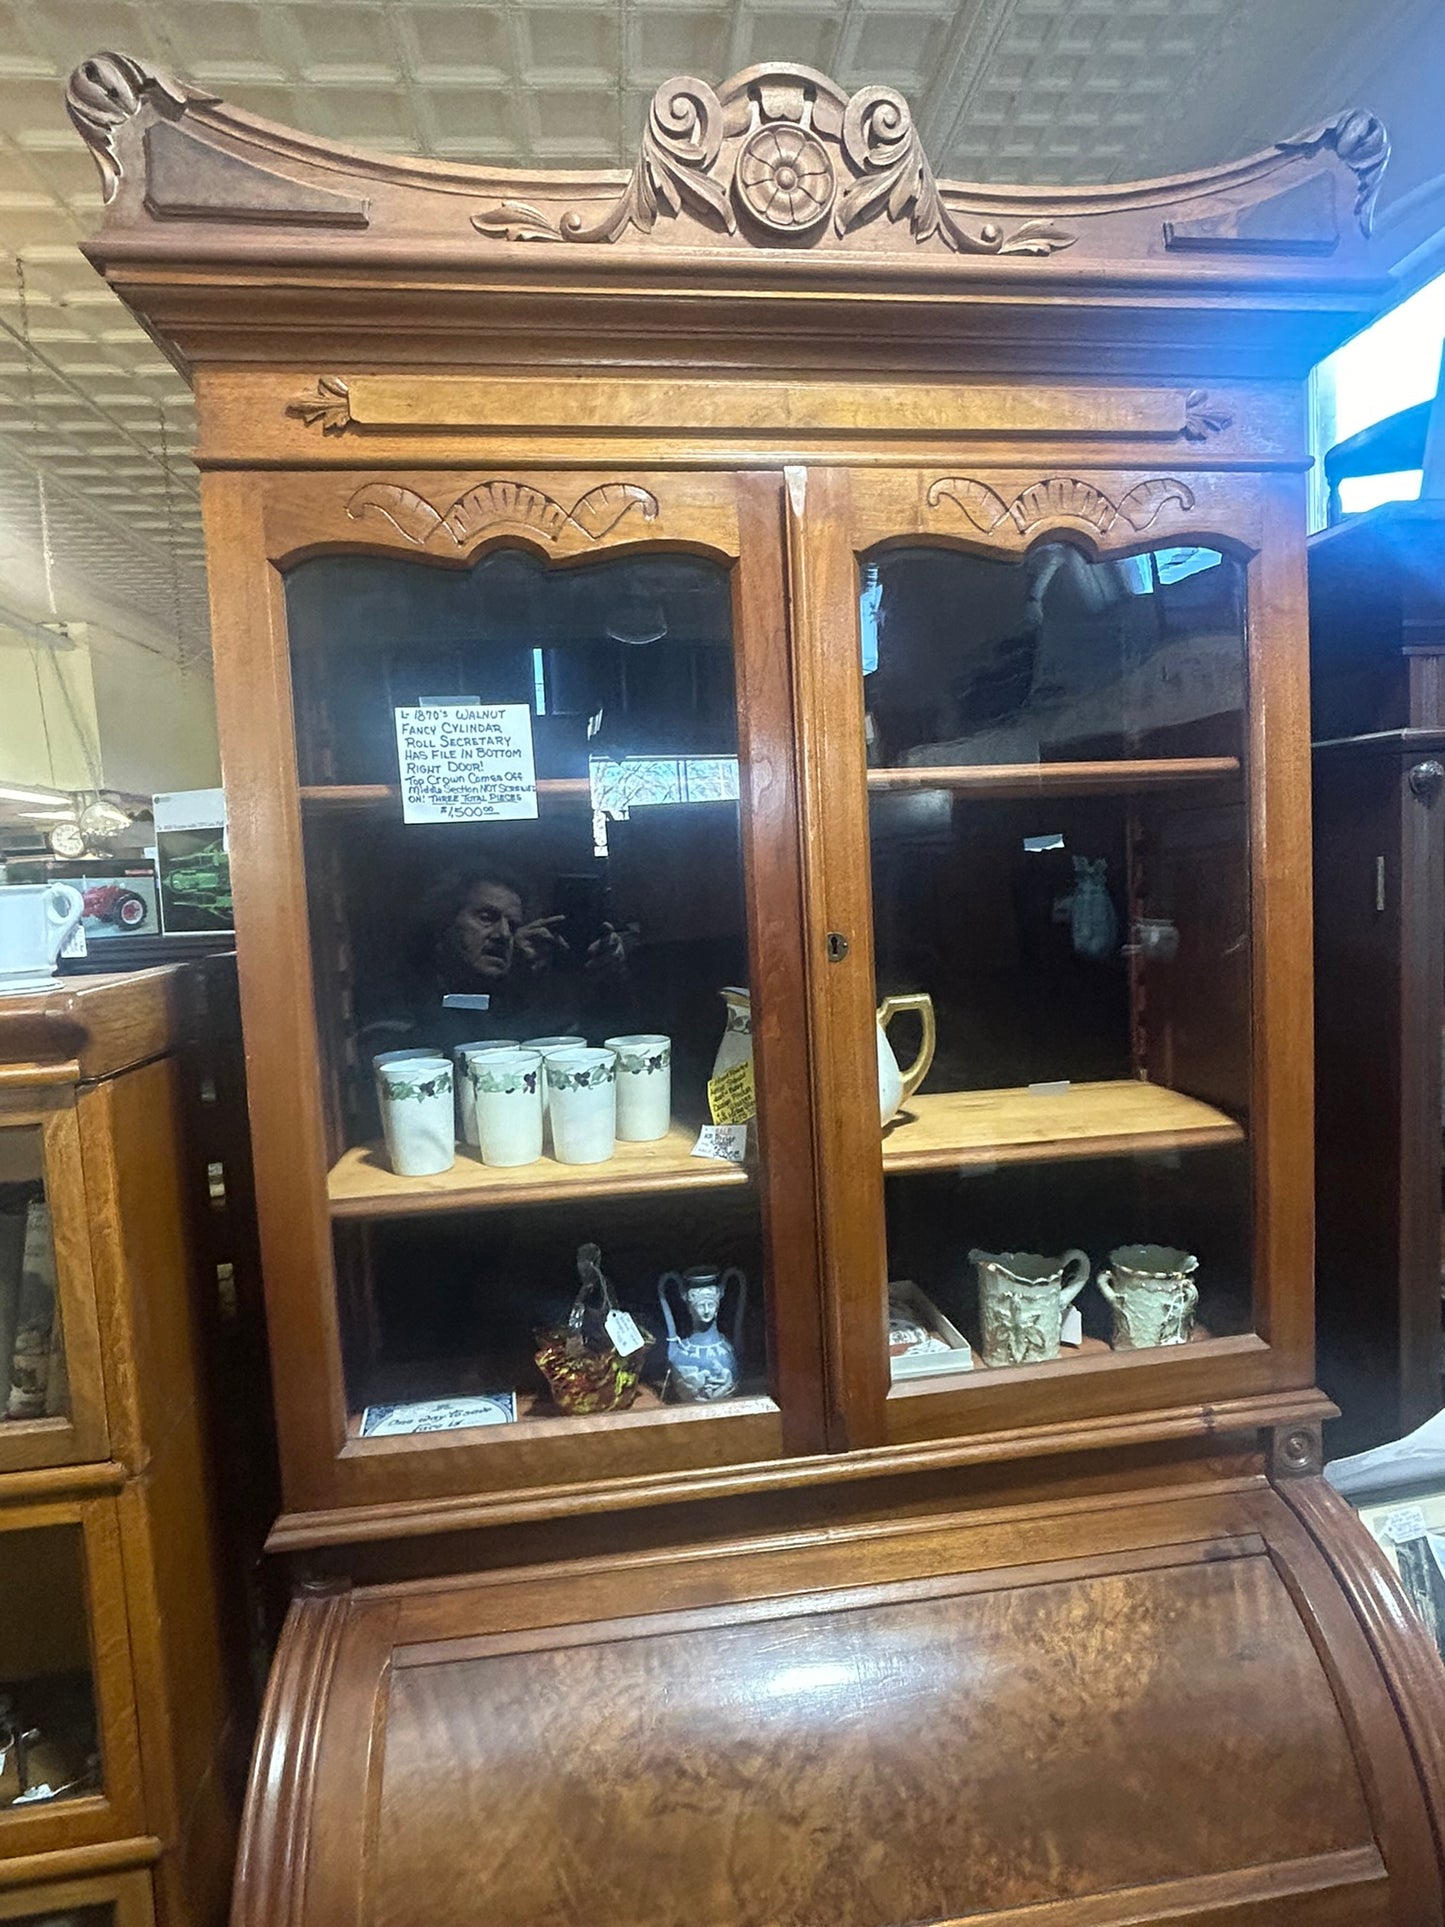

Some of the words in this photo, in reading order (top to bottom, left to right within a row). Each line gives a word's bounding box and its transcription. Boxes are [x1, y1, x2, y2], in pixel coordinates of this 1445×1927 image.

[456, 709, 506, 719] WALNUT
[402, 723, 436, 735] FANCY
[442, 722, 503, 733] CYLINDAR
[405, 737, 436, 748] ROLL
[440, 735, 511, 747] SECRETARY
[405, 750, 428, 760] HAS
[432, 750, 456, 759] FILE
[461, 749, 472, 758] IN
[477, 748, 521, 758] BOTTOM
[407, 763, 441, 774] RIGHT
[448, 761, 484, 772] DOOR!
[460, 794, 487, 802] TOTAL
